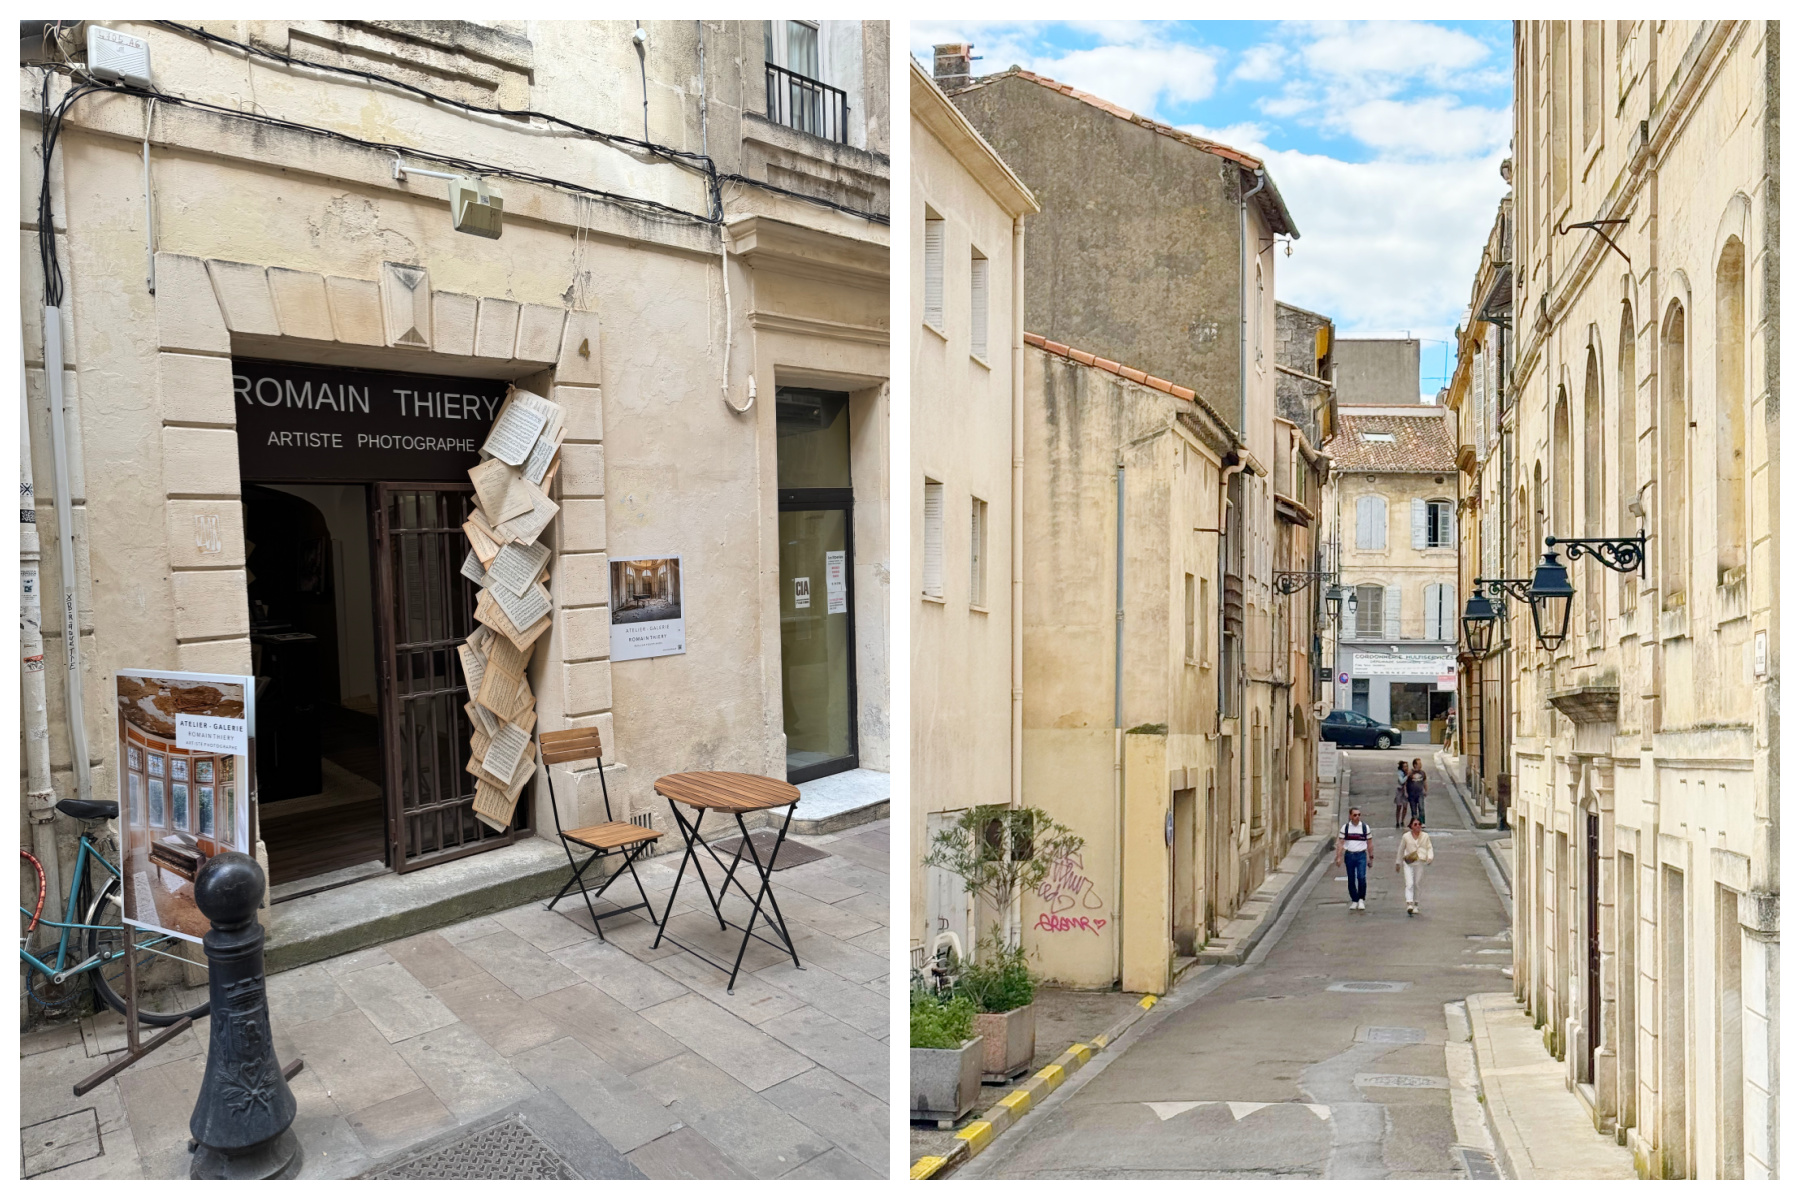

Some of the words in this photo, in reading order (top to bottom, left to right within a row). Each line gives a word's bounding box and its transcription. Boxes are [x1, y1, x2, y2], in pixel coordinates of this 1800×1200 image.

[233, 374, 370, 414] ROMAIN
[392, 388, 499, 421] THIERY
[267, 431, 343, 448] ARTISTE
[357, 433, 476, 452] PHOTOGRAPHE
[796, 581, 809, 596] CIA
[214, 724, 244, 732] GALERIE
[188, 731, 212, 739] ROMAIN
[213, 733, 234, 741] THIERY
